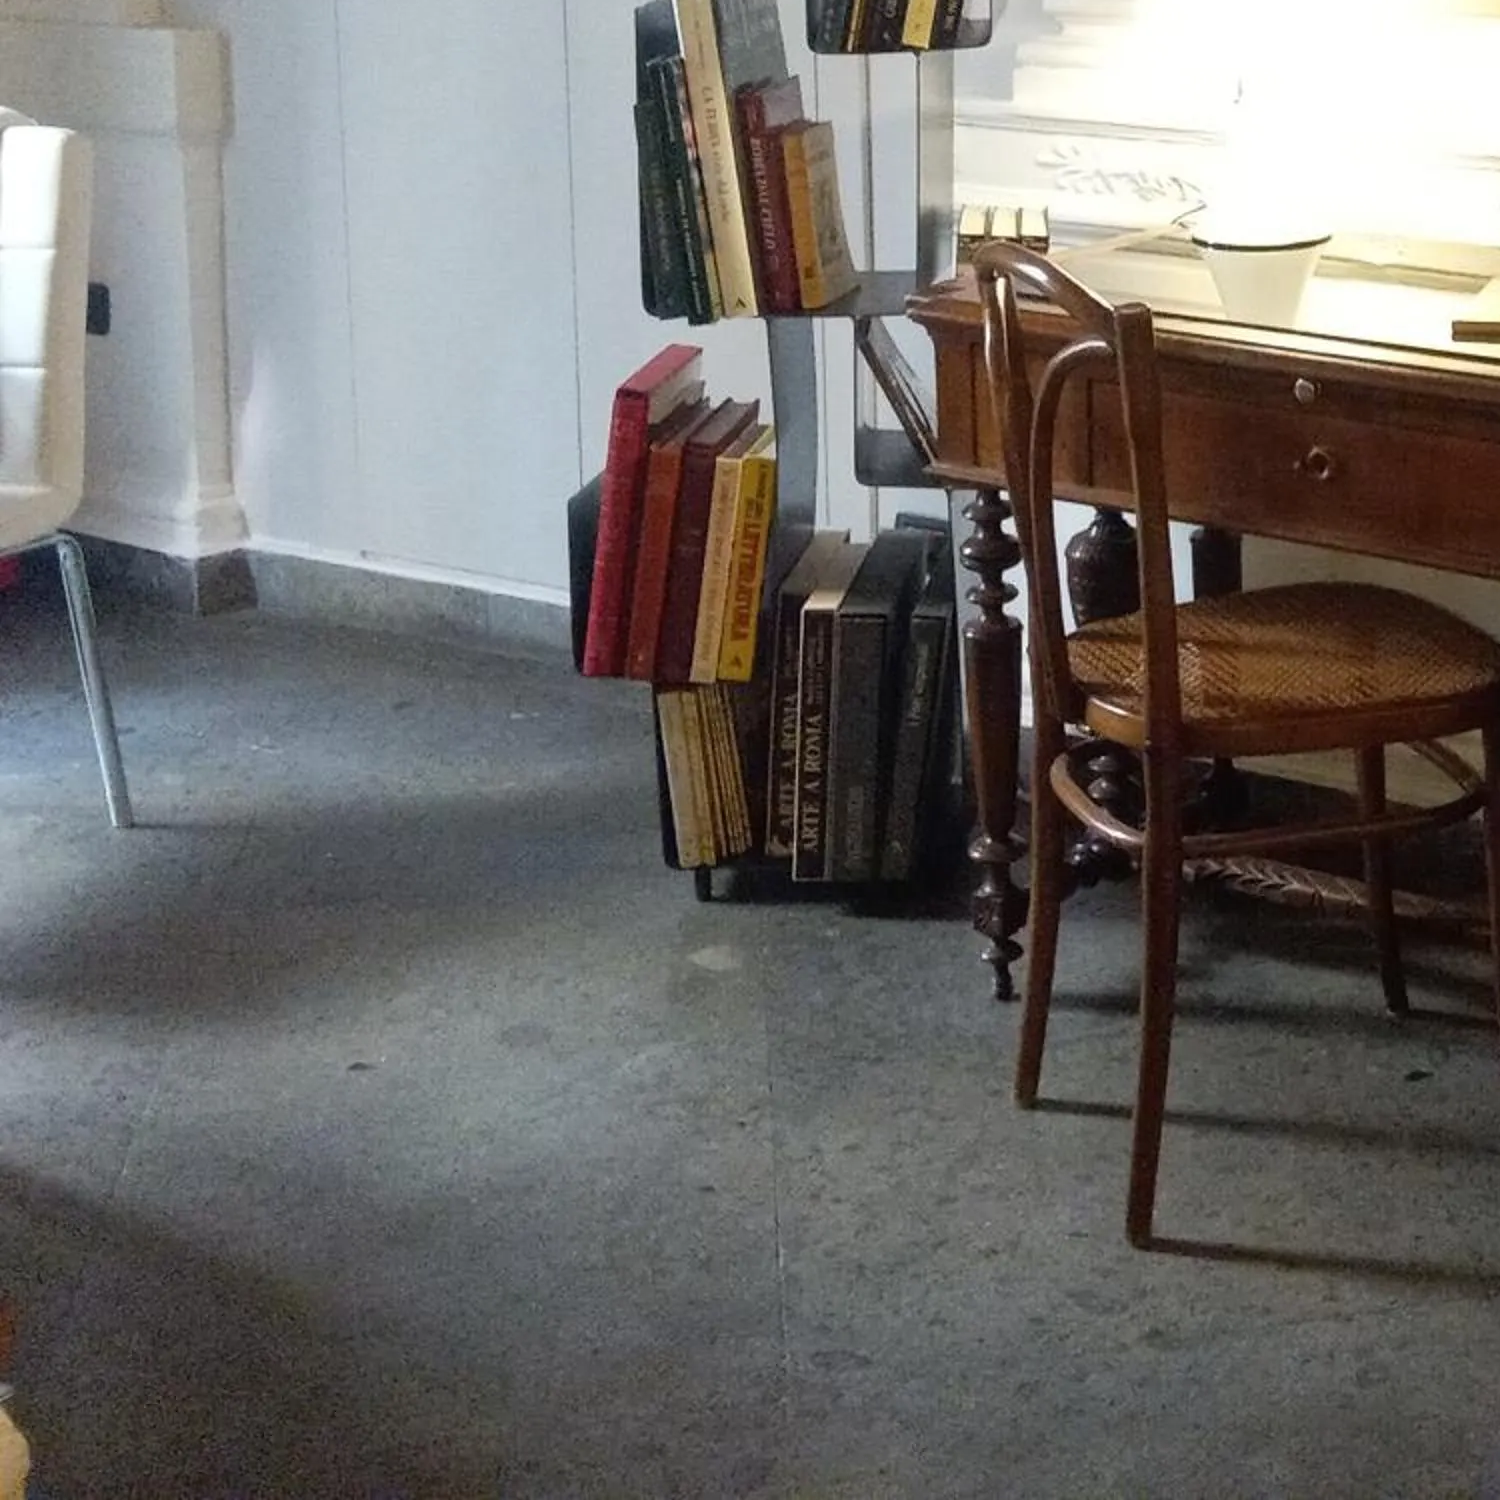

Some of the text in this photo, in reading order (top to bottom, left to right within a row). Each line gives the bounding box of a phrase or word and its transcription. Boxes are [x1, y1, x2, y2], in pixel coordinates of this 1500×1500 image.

[803, 713, 823, 773] ROMA
[803, 780, 821, 794] A
[802, 801, 821, 852] ARTE
